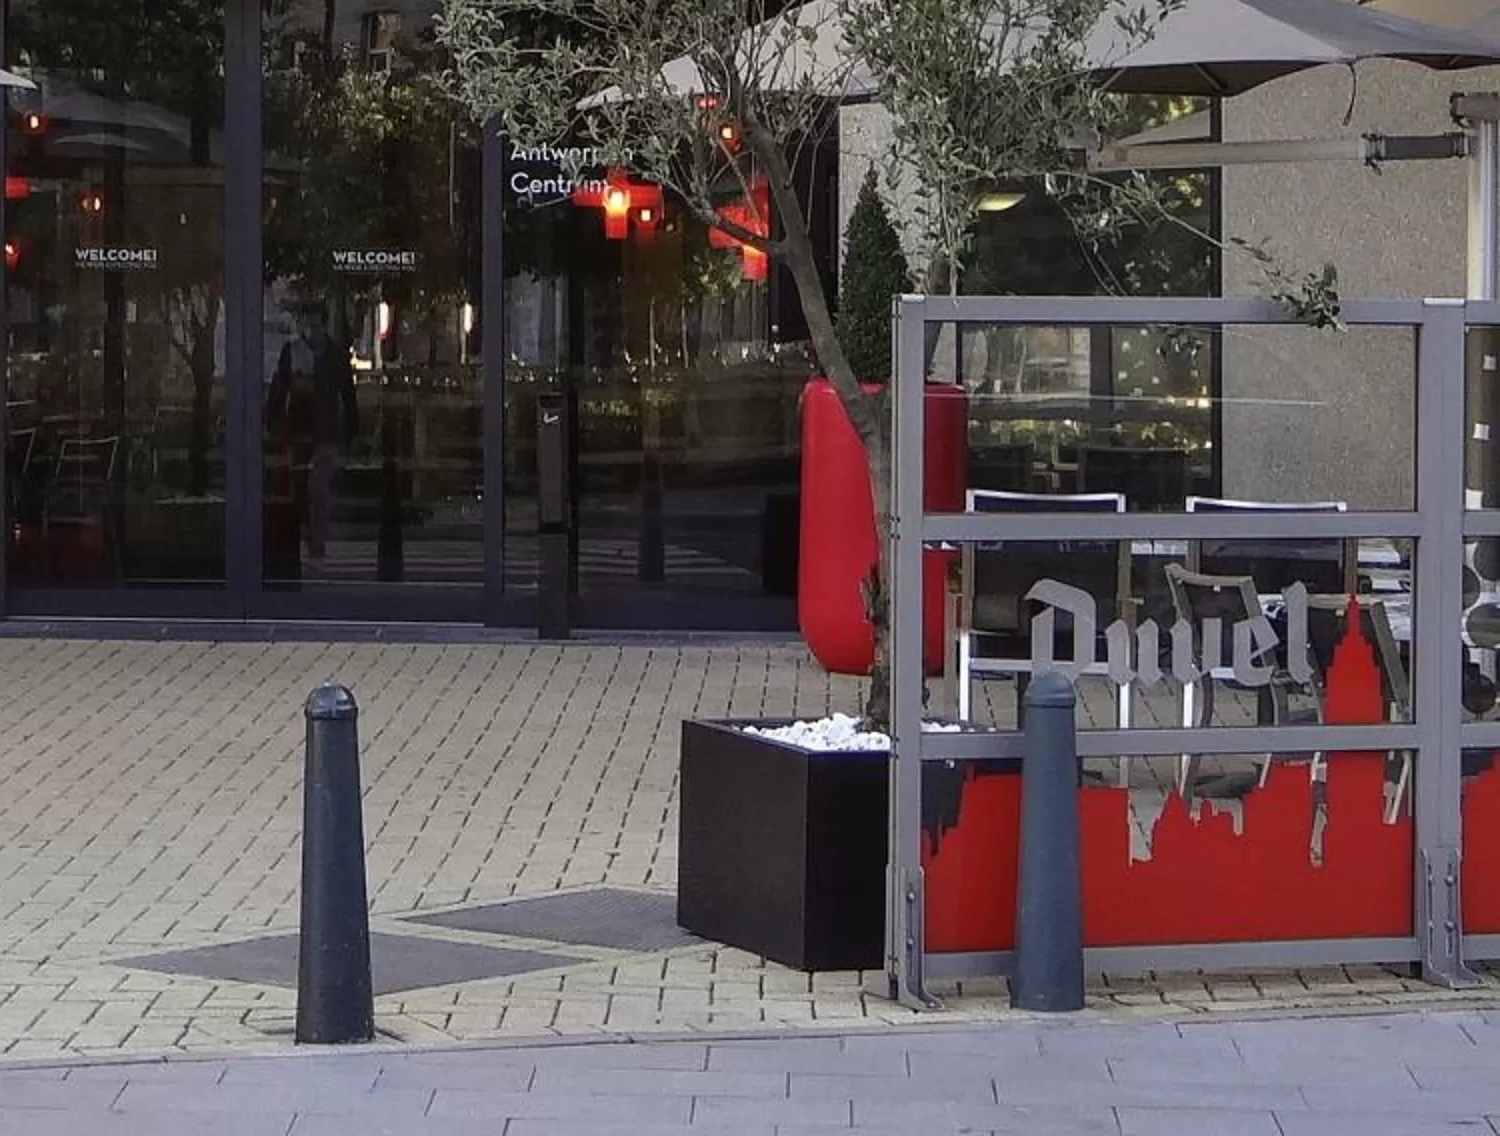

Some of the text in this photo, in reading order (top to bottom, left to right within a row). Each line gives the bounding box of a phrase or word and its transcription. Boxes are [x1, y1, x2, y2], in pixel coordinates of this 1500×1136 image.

[510, 141, 634, 168] Antwern
[75, 248, 157, 261] WELCOME!
[333, 251, 415, 264] WELCOME!
[1024, 578, 1315, 686] Duvel
